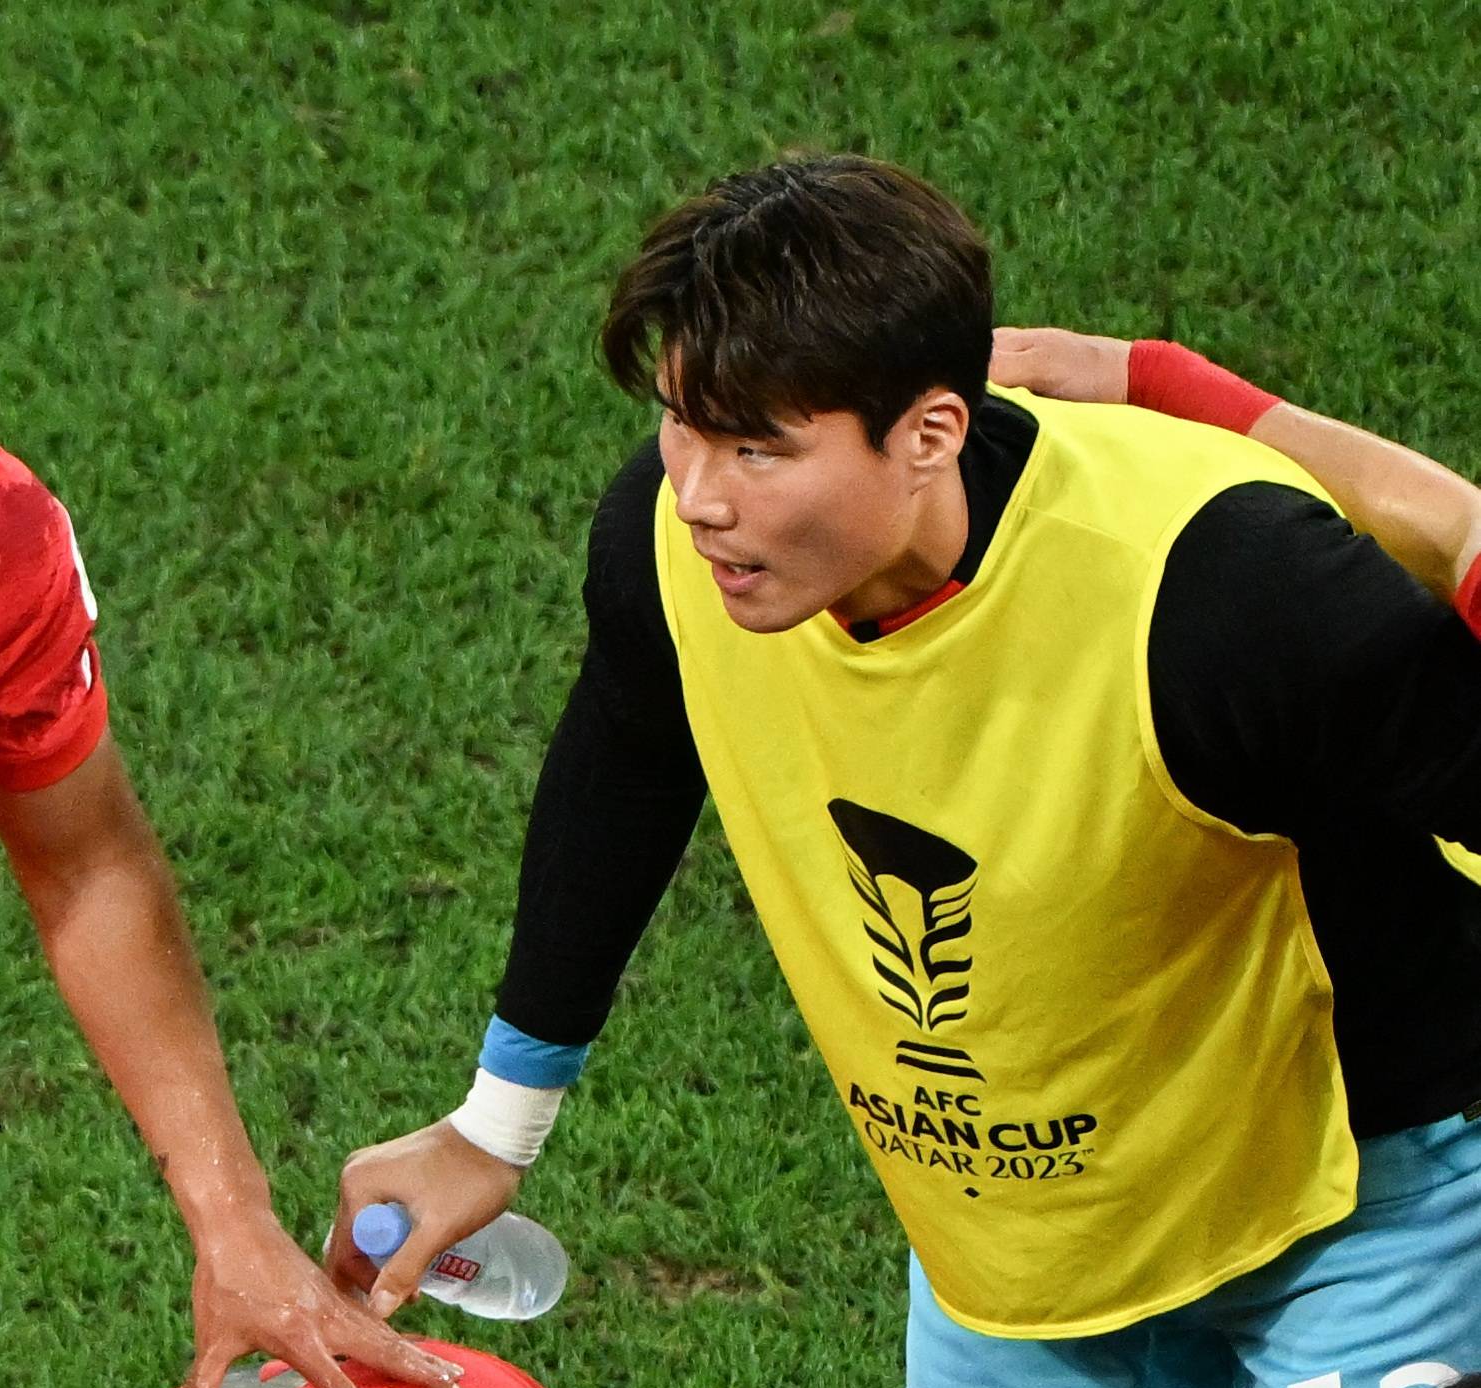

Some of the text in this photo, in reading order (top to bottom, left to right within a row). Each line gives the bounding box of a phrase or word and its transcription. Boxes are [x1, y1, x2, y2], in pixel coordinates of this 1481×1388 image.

[849, 1082, 1098, 1152] ASIAN CUP
[914, 1085, 983, 1117] AFC
[864, 1120, 981, 1177] QATAR
